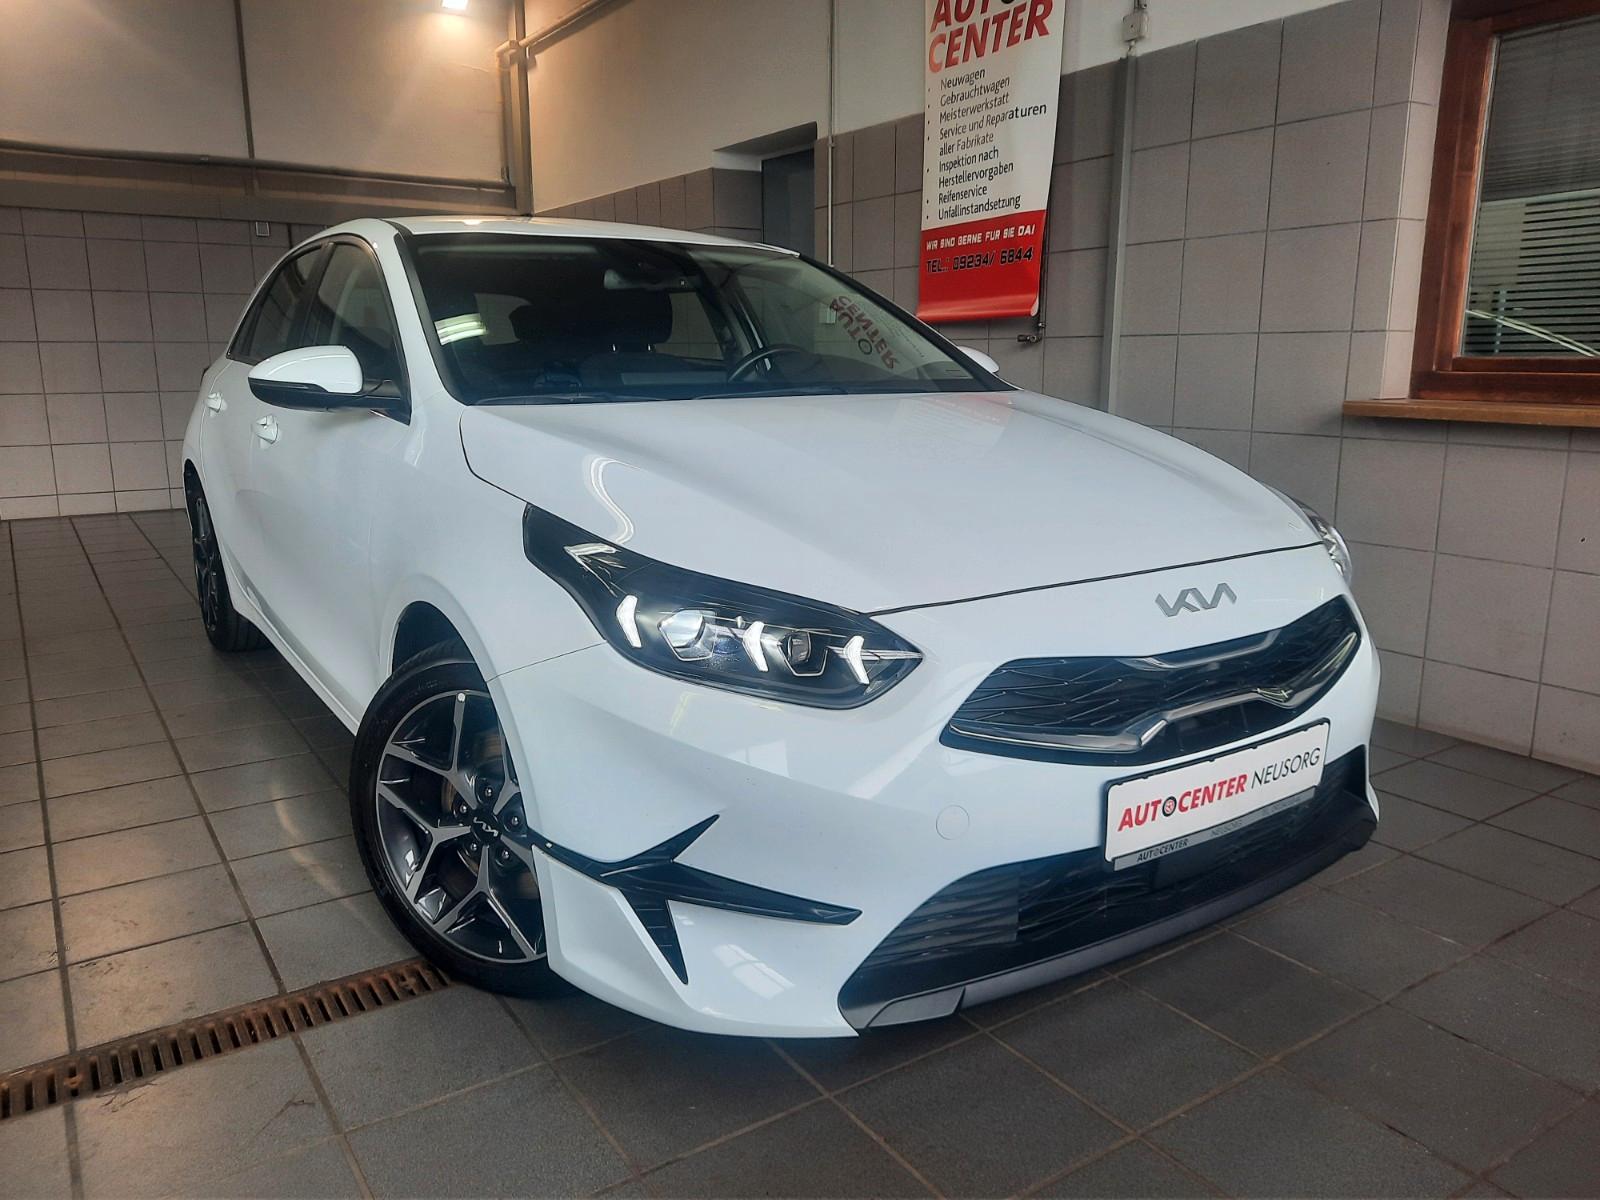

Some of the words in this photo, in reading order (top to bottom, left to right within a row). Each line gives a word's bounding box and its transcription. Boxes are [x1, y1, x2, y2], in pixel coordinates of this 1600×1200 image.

[928, 0, 1053, 73] CENTER
[940, 68, 986, 90] Neuwagen
[940, 76, 1010, 107] Gebrauchtwagen
[939, 93, 1010, 124] Meisterwerkstatt
[939, 124, 967, 140] Service
[968, 116, 984, 132] und
[985, 104, 1047, 128] Reparaturen
[939, 141, 955, 157] aller
[956, 132, 994, 151] Fabrikate
[939, 154, 977, 174] Inspektion
[978, 146, 999, 163] nach
[938, 161, 1014, 189] Herstellervorgaben
[938, 184, 988, 205] Reifenservice
[938, 194, 1021, 221] Unfallinstandsetzung
[926, 239, 938, 251] WIR
[940, 236, 955, 249] SIND
[957, 232, 982, 246] GERNE
[1003, 226, 1015, 239] SIE
[952, 250, 995, 272] 09234/
[1000, 246, 1034, 266] 6844
[1155, 582, 1237, 617] KIA
[1250, 747, 1321, 789] NEUSORG
